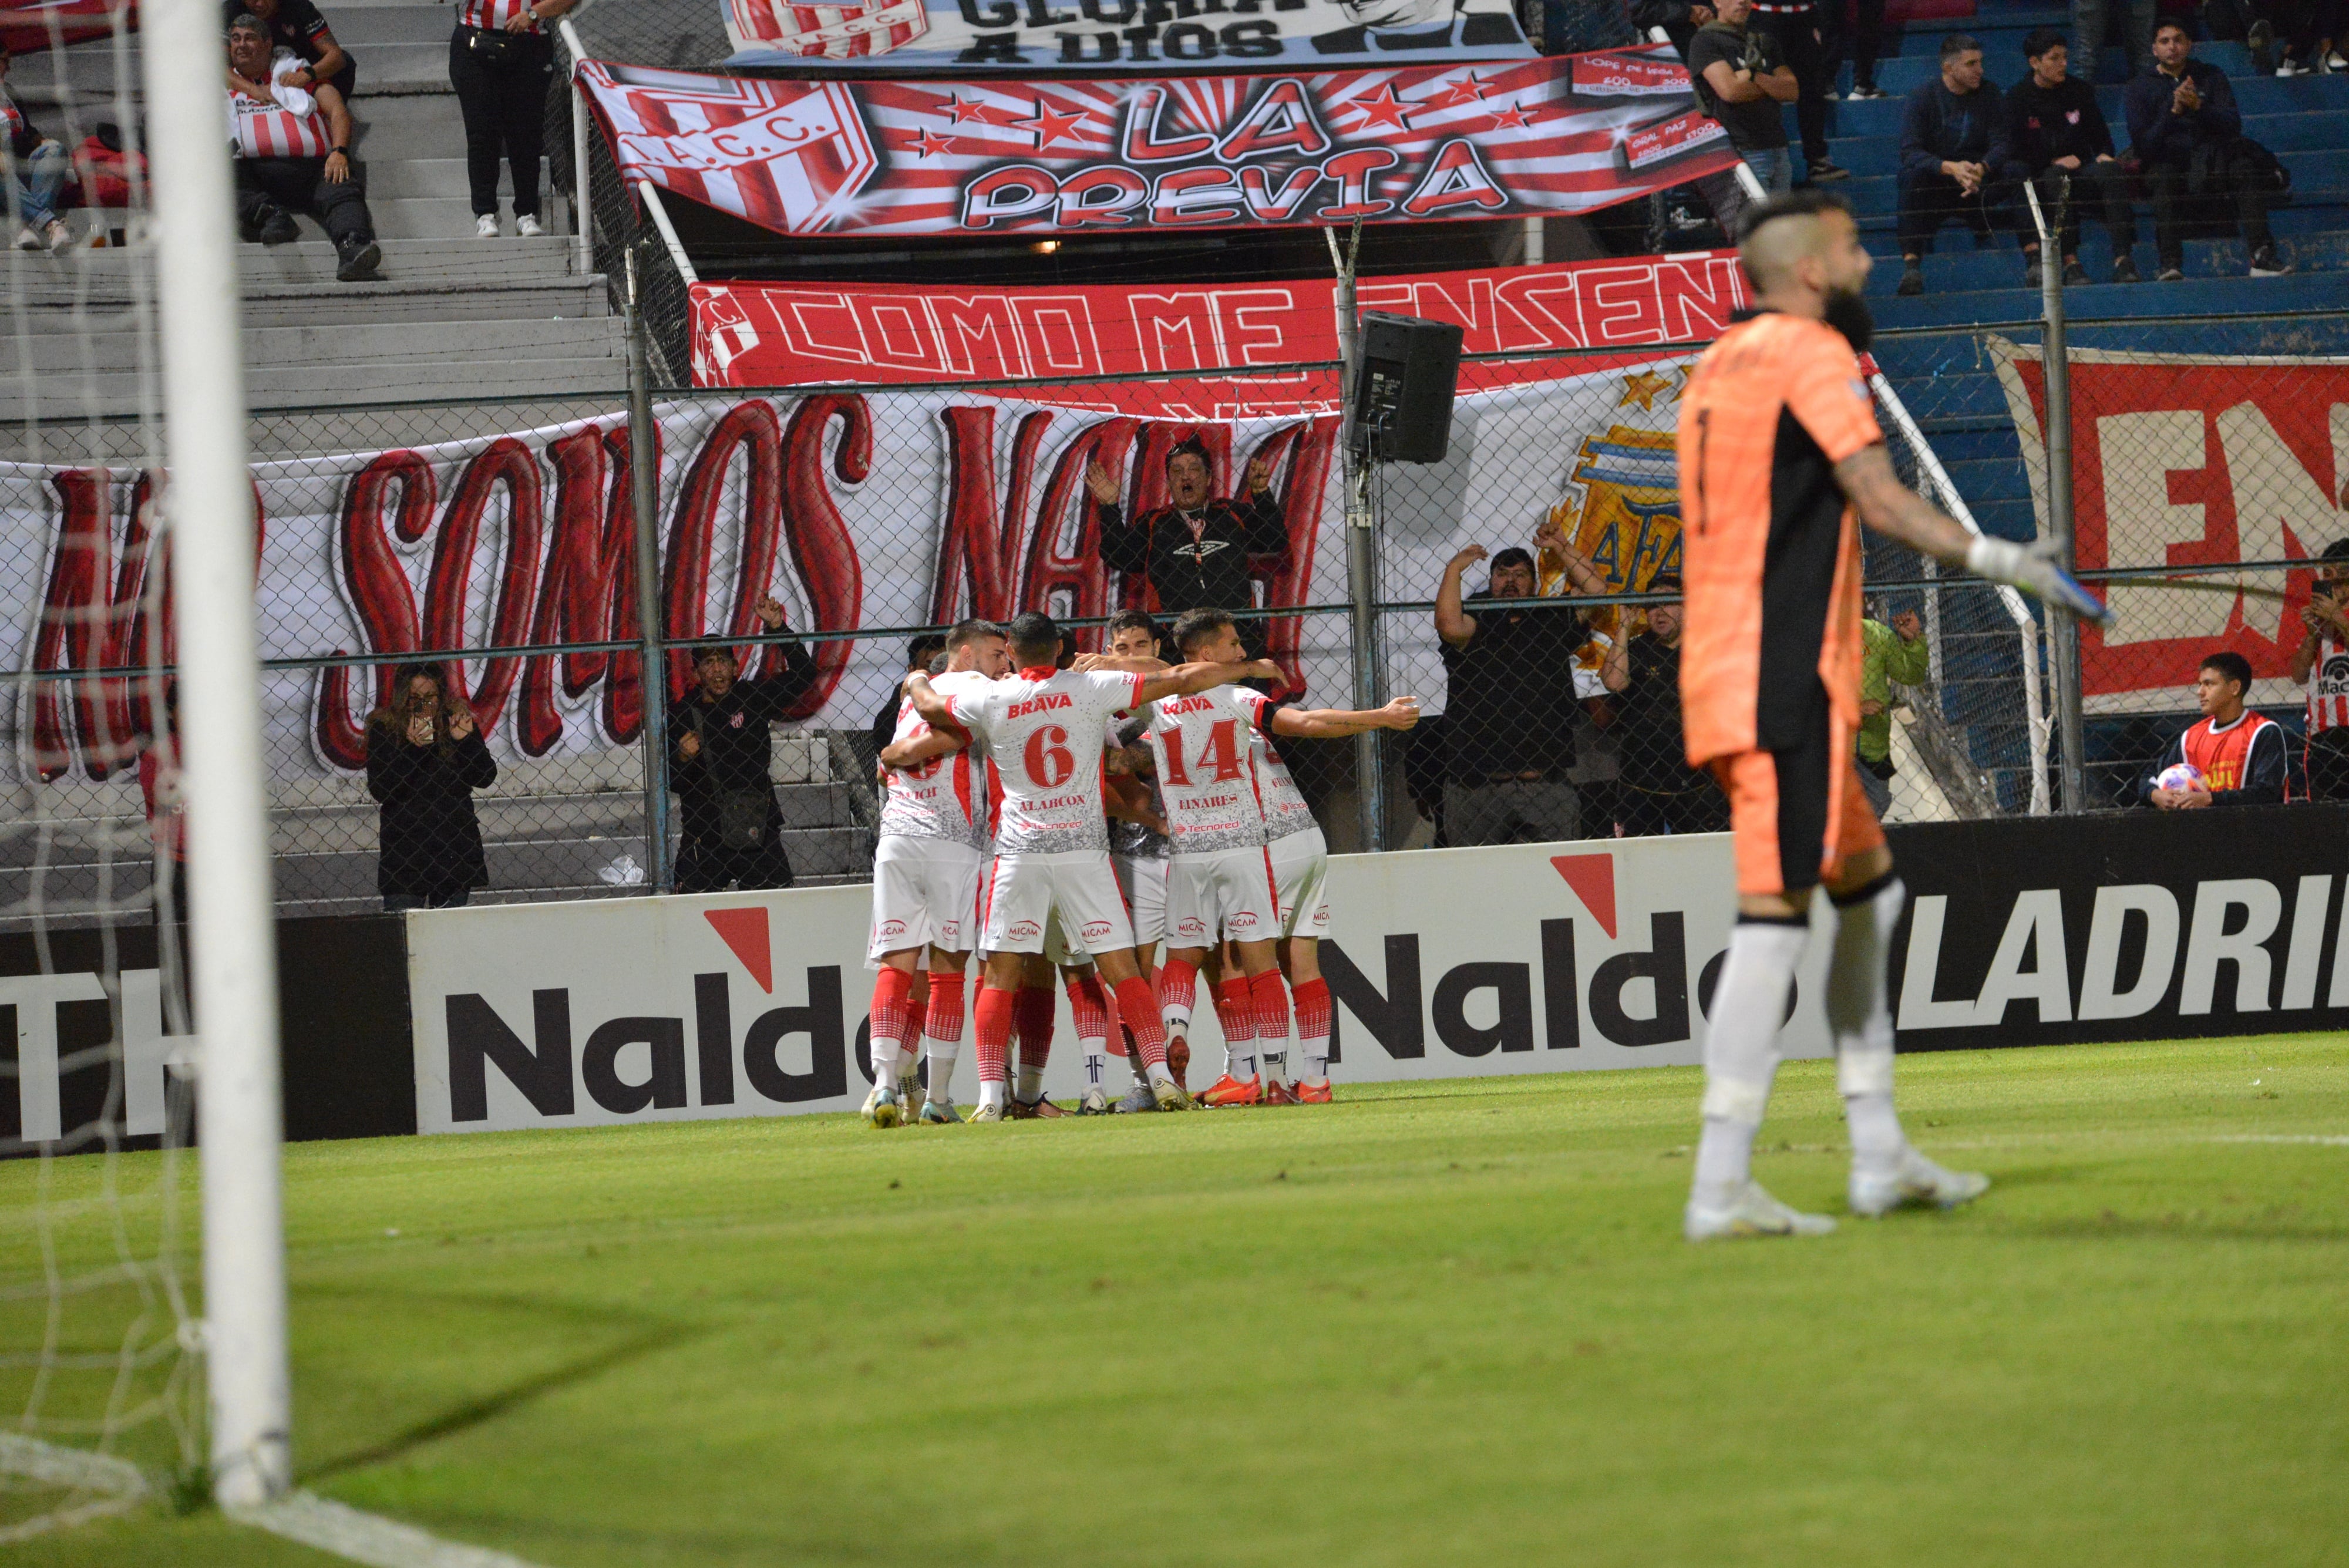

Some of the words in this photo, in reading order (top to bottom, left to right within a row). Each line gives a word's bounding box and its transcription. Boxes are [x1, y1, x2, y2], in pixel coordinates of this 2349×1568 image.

[1055, 20, 1285, 62] DIOS
[1584, 56, 1620, 70] LOPE
[1121, 78, 1331, 164] LA
[1664, 119, 1688, 134] PAZ
[961, 138, 1509, 229] PREVIA
[761, 288, 1104, 383] COMO
[1128, 289, 1307, 382] ME
[1007, 695, 1073, 720] BRAVA
[1163, 697, 1215, 719] BRAVA
[1023, 724, 1076, 789] 6
[1159, 718, 1246, 787] 14
[1179, 794, 1238, 810] LINARES
[1188, 820, 1240, 833] Tecnored
[880, 926, 905, 936] MICAM
[1008, 927, 1038, 937] MICAM
[1081, 926, 1110, 938] MICAM
[1227, 917, 1257, 927] MICAM
[1896, 874, 2349, 1031] LADRI
